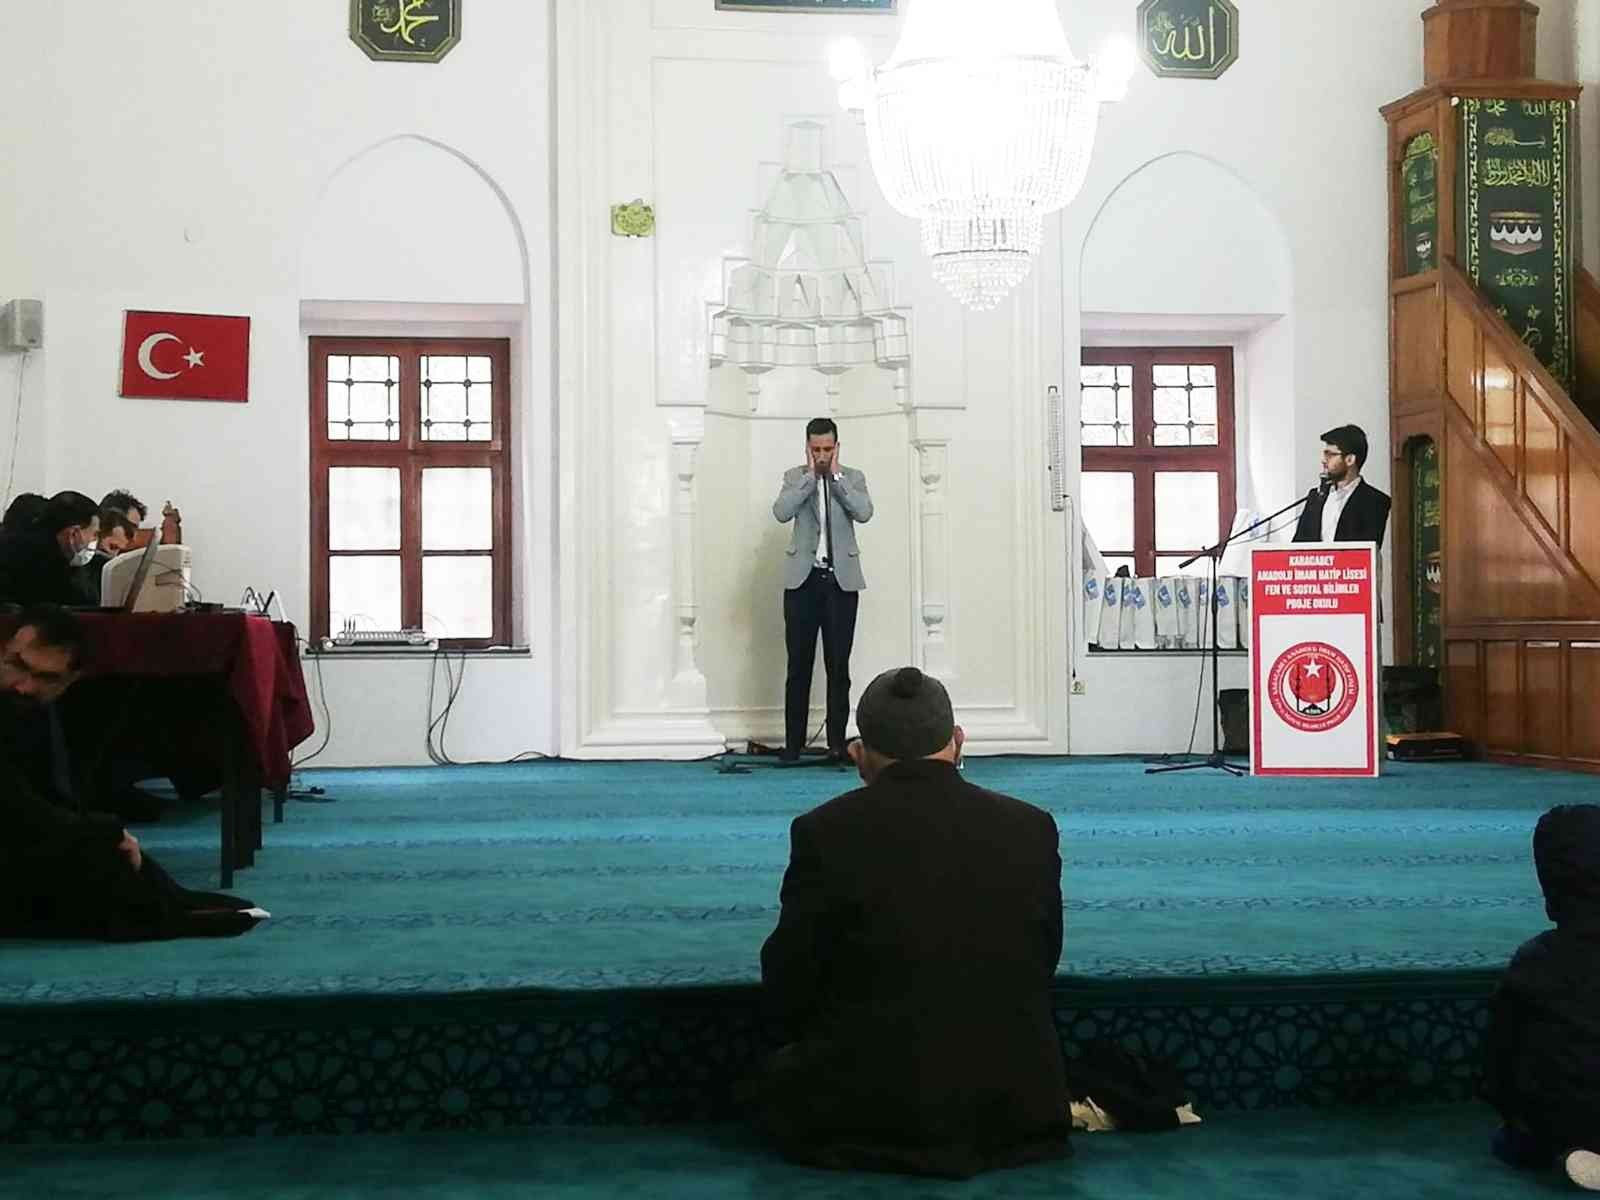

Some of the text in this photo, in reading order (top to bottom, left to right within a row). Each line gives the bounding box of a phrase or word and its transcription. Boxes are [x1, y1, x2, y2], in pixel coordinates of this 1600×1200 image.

[1152, 6, 1215, 65] الله
[1318, 568, 1341, 580] HATİP
[1265, 584, 1281, 595] FEN
[1281, 584, 1292, 595] VE
[1286, 598, 1312, 609] PROJE
